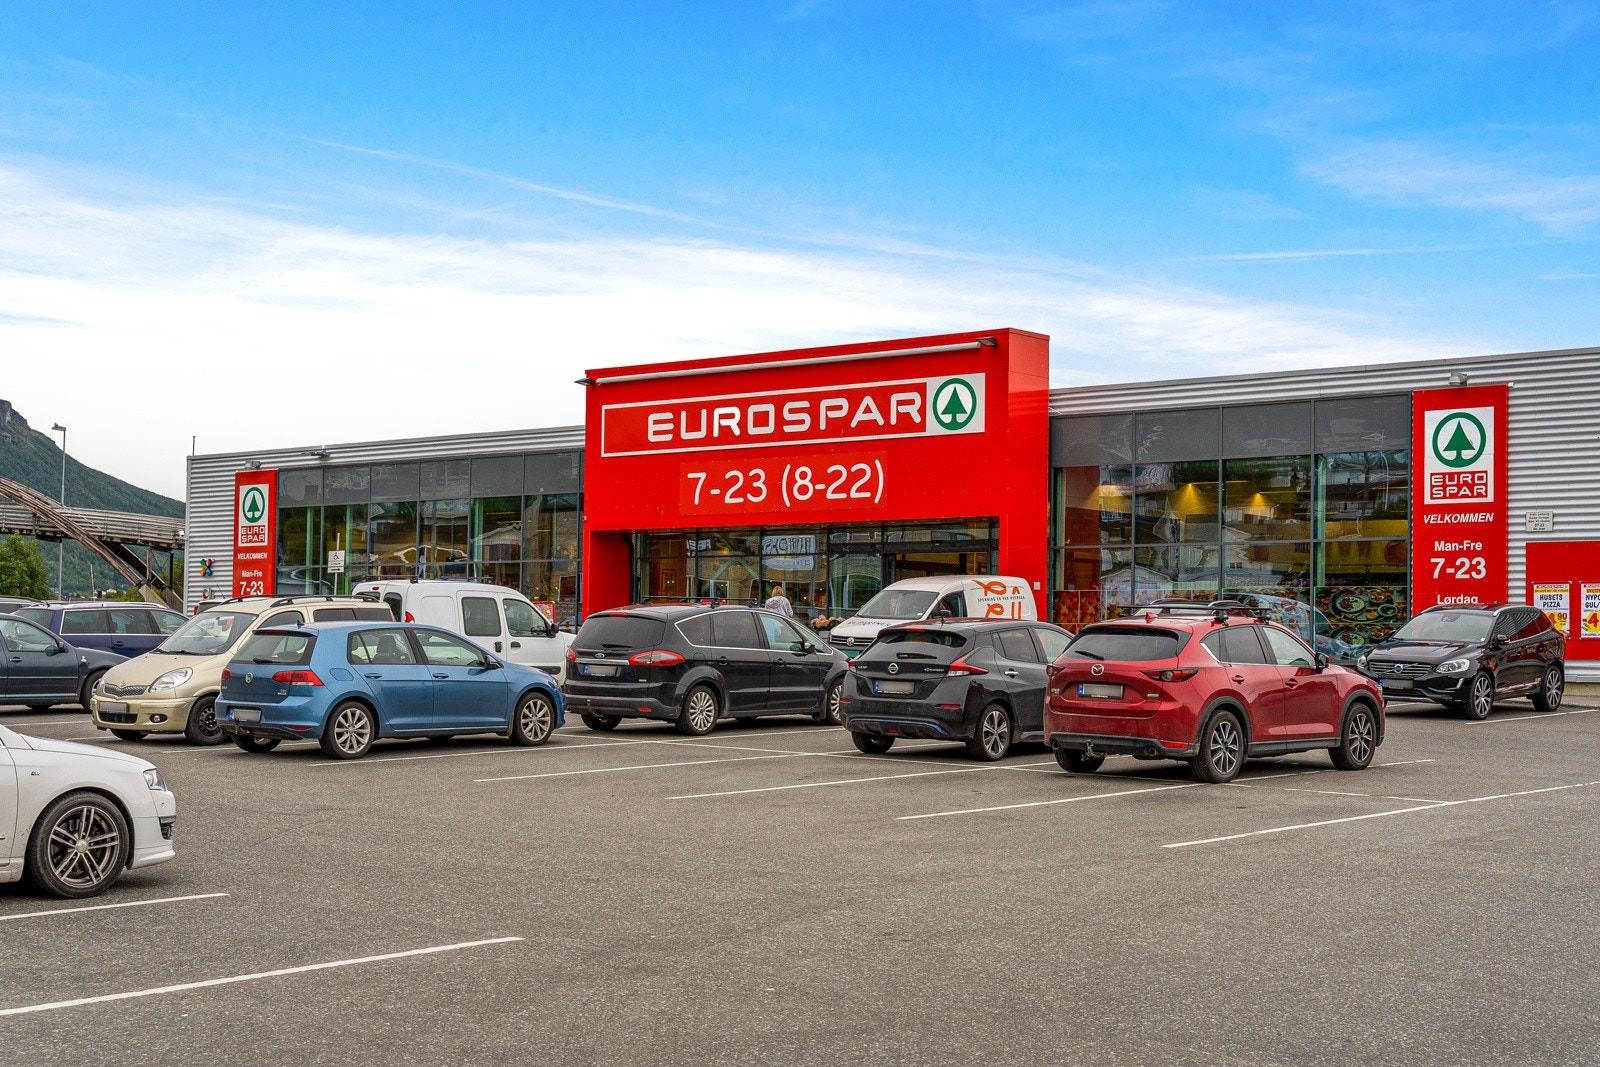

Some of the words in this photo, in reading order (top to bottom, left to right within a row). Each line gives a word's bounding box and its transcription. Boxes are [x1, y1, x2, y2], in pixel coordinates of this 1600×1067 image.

[647, 391, 922, 442] EUROSPAR
[687, 468, 767, 505] 7-23
[781, 458, 885, 507] (8-22)
[1431, 472, 1487, 486] EURO
[1432, 485, 1487, 498] SPAR
[1423, 512, 1494, 524] VELKOMMEN
[241, 526, 265, 534] EURO
[241, 534, 265, 543] SPAR
[1434, 540, 1483, 552] Man-Fre
[237, 552, 268, 560] VELKOMMEN
[241, 569, 263, 578] Man-Fre
[1430, 557, 1487, 579] 7-23
[240, 580, 264, 596] 7-23
